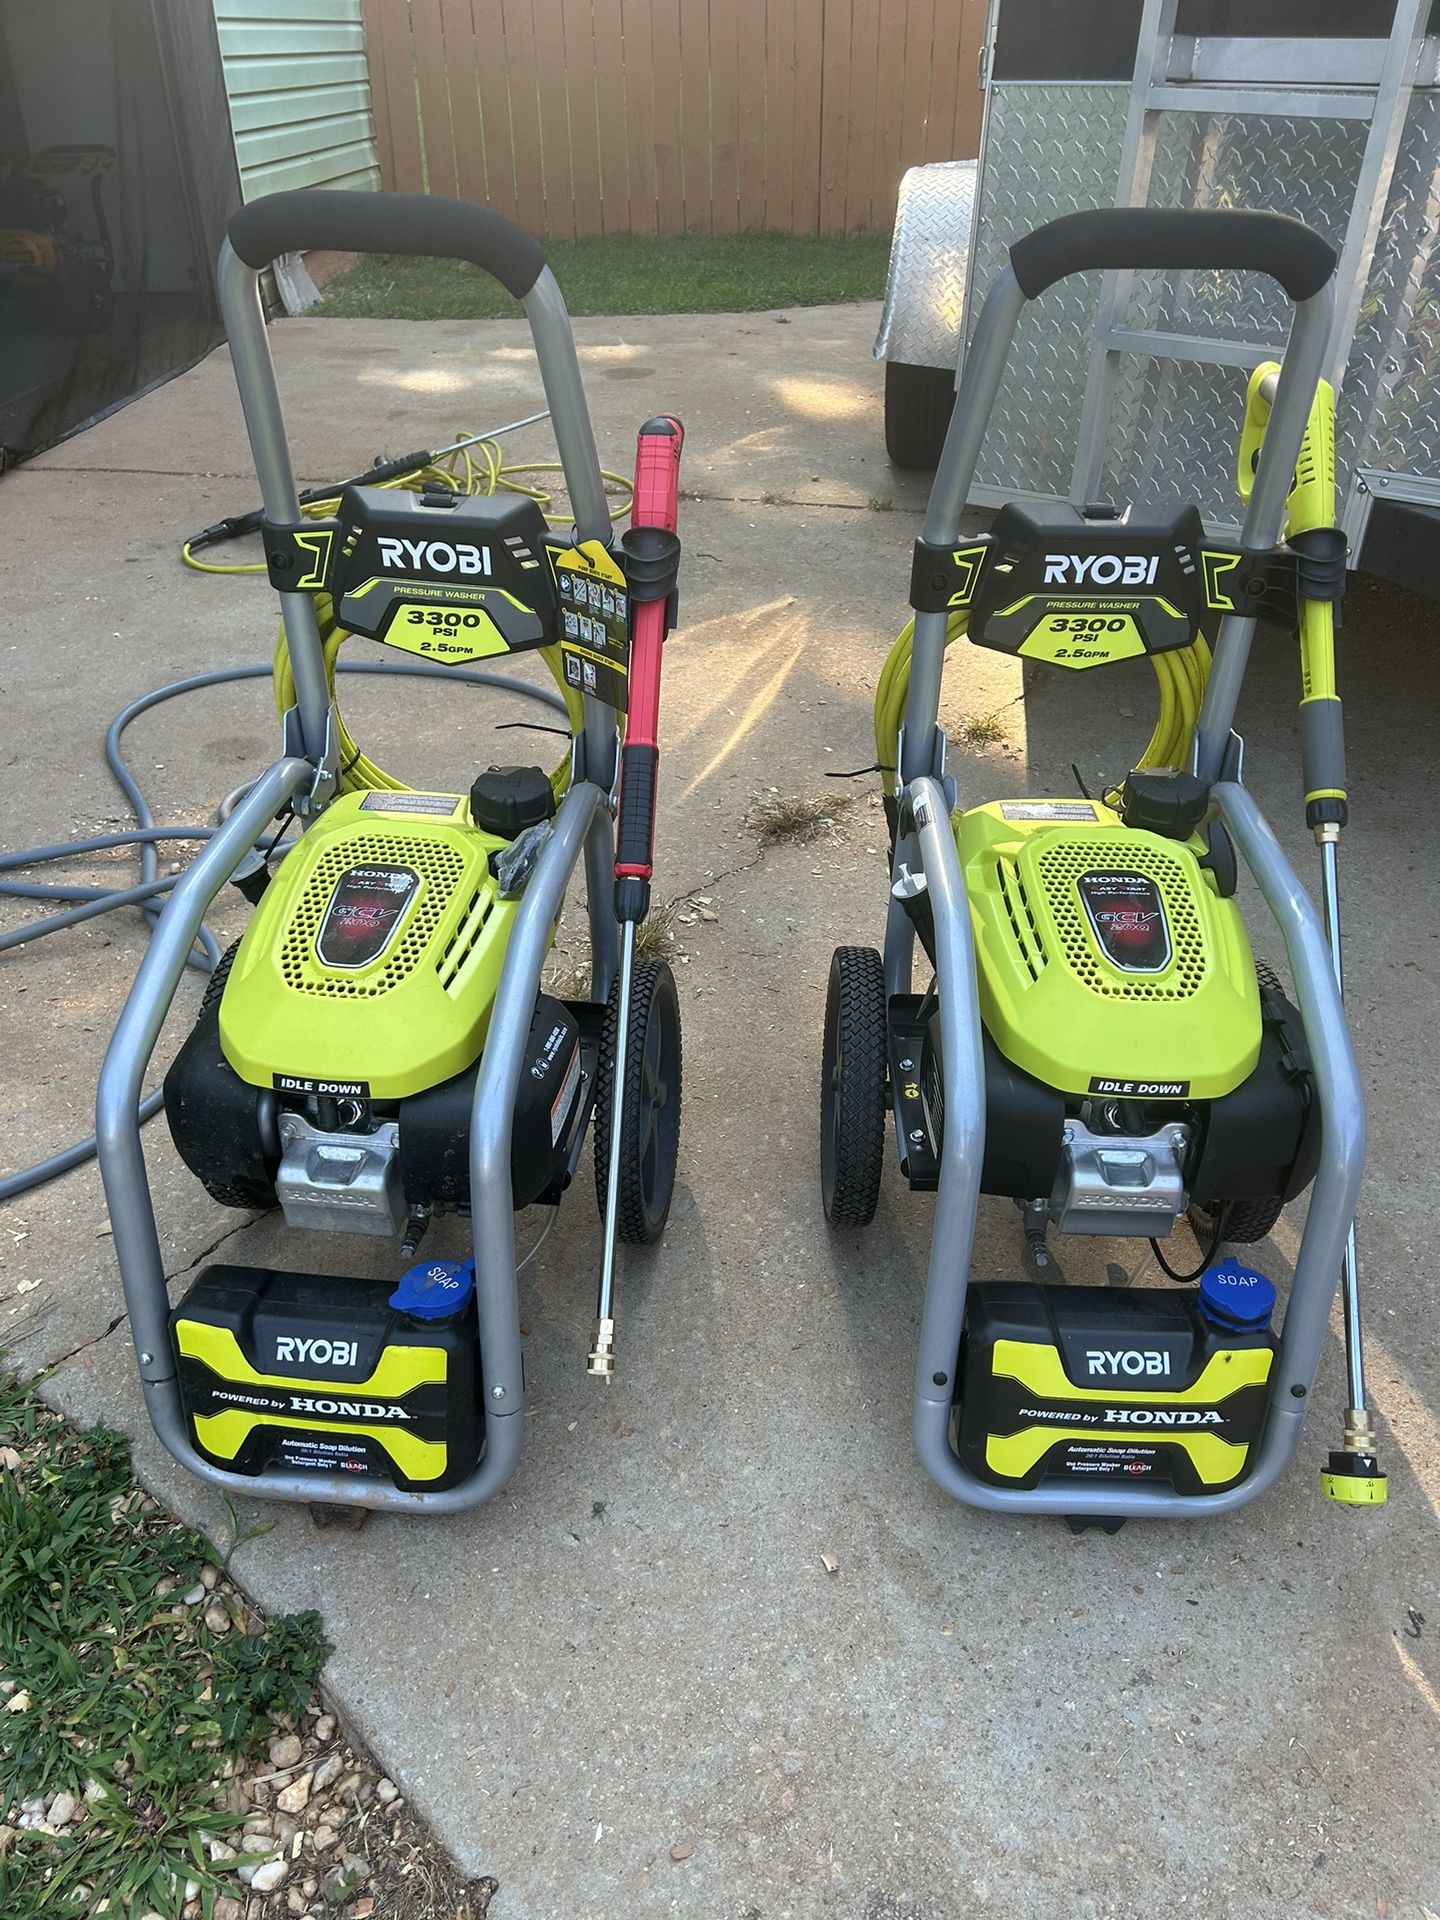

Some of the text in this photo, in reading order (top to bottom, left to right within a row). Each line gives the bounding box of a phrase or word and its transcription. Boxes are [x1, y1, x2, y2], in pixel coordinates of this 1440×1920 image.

[377, 537, 492, 576] RYOBI
[1044, 555, 1160, 585] RYOBI
[393, 586, 486, 600] PRESSURE WASHER
[1047, 601, 1096, 609] PRESSURE
[407, 610, 480, 628] 3300
[1049, 618, 1126, 633] 3300
[432, 627, 457, 637] PSI
[1072, 634, 1099, 642] PSI
[420, 642, 473, 654] 2.5GPM
[1054, 649, 1110, 658] 2.5GPM
[332, 905, 399, 919] GCV
[1095, 912, 1160, 922] GCV
[281, 1078, 361, 1094] IDLE DOWN
[1098, 1081, 1183, 1094] IDLE DOWN
[1078, 1194, 1172, 1208] HONDA
[428, 1267, 459, 1289] SOAP
[1217, 1274, 1258, 1287] SOAP
[276, 1336, 358, 1366] RYOBI
[1086, 1350, 1170, 1375] RYOBI
[211, 1390, 411, 1419] POWERED by HONDA
[1018, 1408, 1224, 1424] POWERED by HONDA
[282, 1439, 366, 1453] Automatic Soap Dilution
[341, 1462, 368, 1470] BLEACH
